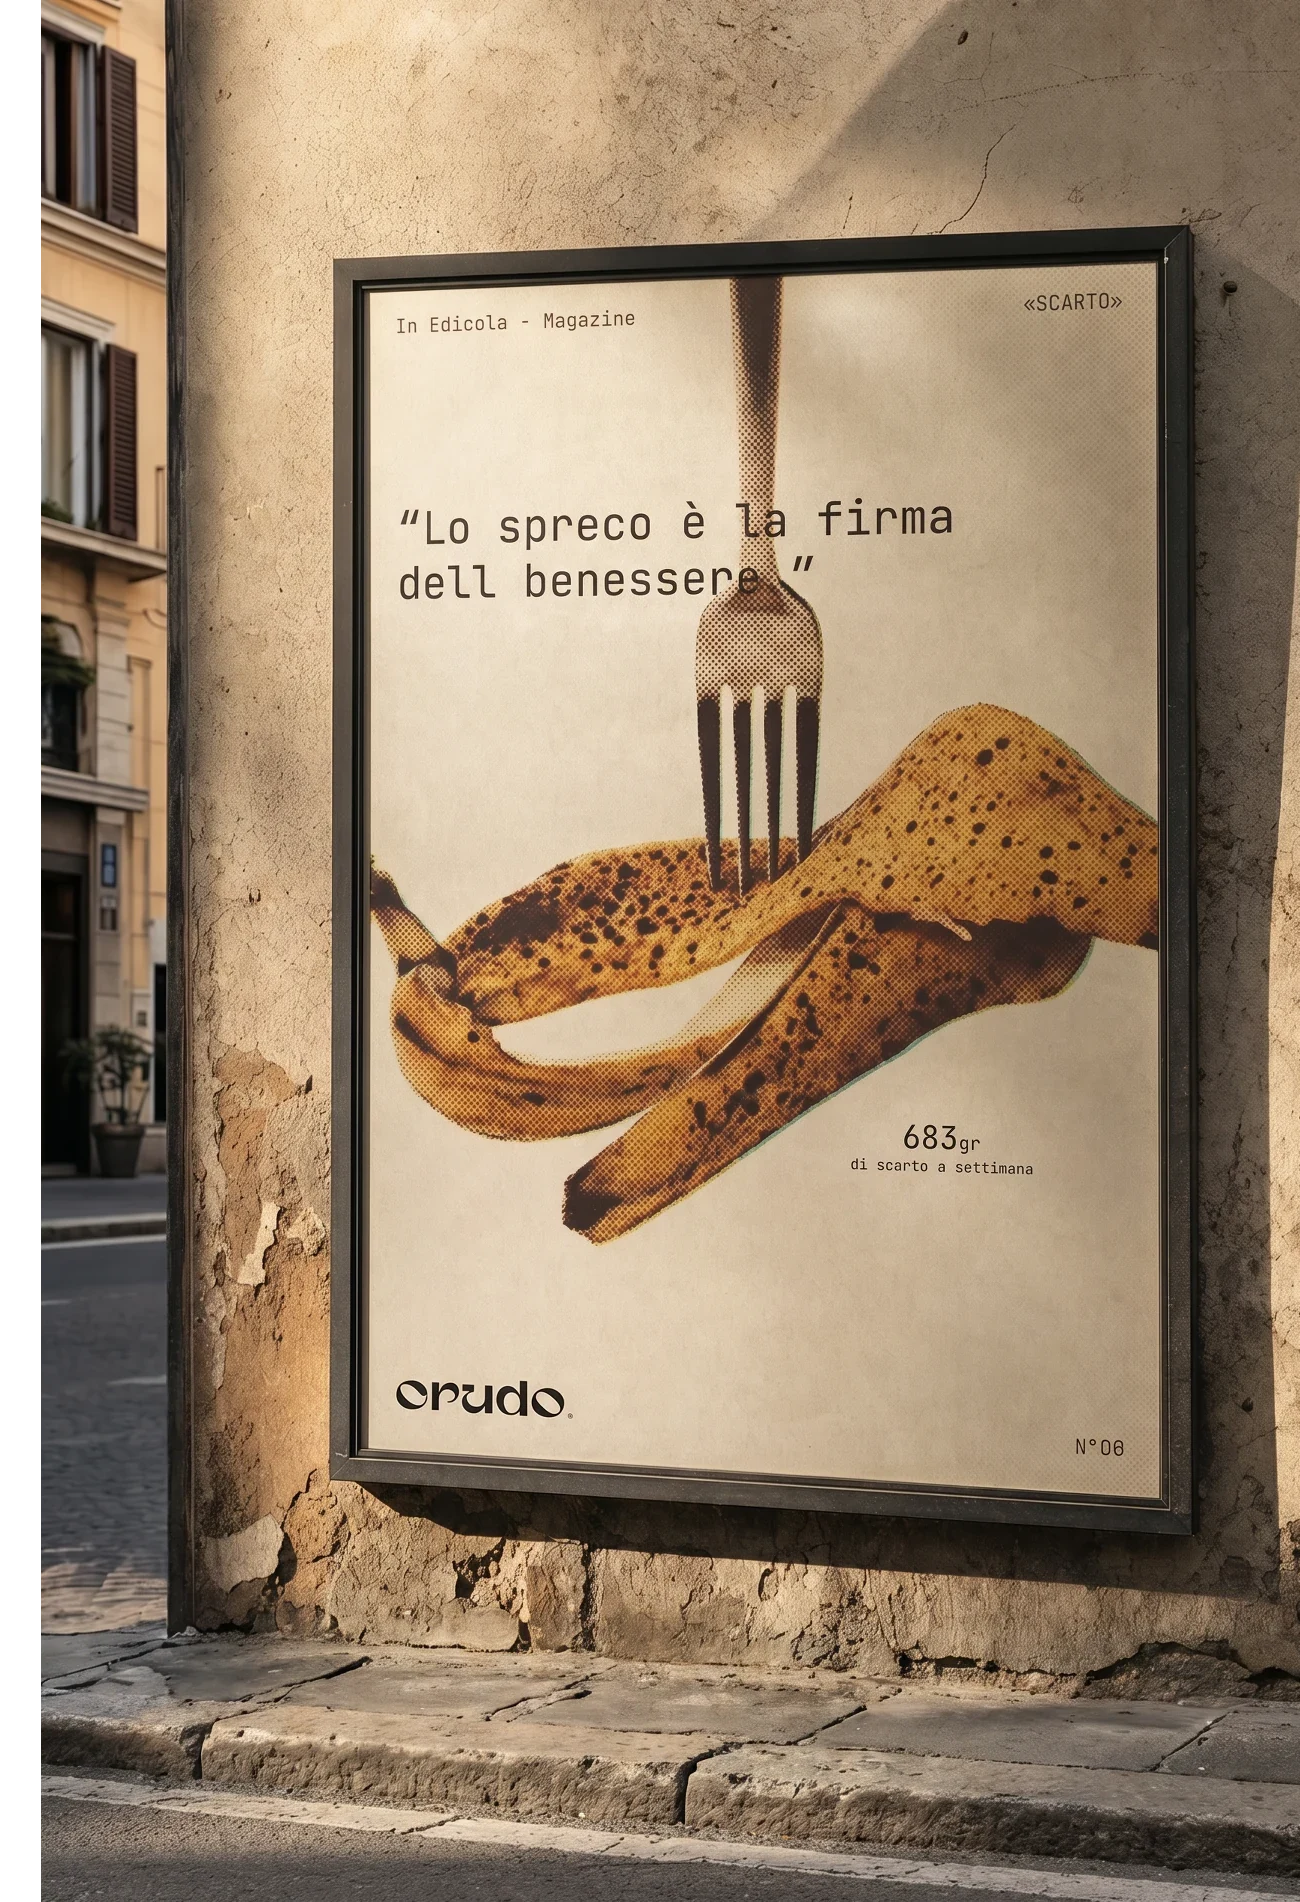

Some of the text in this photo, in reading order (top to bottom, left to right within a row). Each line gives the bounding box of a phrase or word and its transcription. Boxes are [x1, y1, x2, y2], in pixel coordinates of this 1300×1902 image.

[1023, 292, 1123, 312] «SCARTO»
[396, 318, 417, 334] In
[430, 314, 507, 333] Edicola
[544, 309, 635, 332] Magazine
[499, 513, 651, 551] spreco
[683, 500, 705, 539] è
[735, 502, 786, 538] la
[818, 497, 952, 536] firma
[399, 564, 496, 600] dell
[903, 1124, 981, 1155] 683gr
[850, 1157, 1033, 1175] di scarto a settimana
